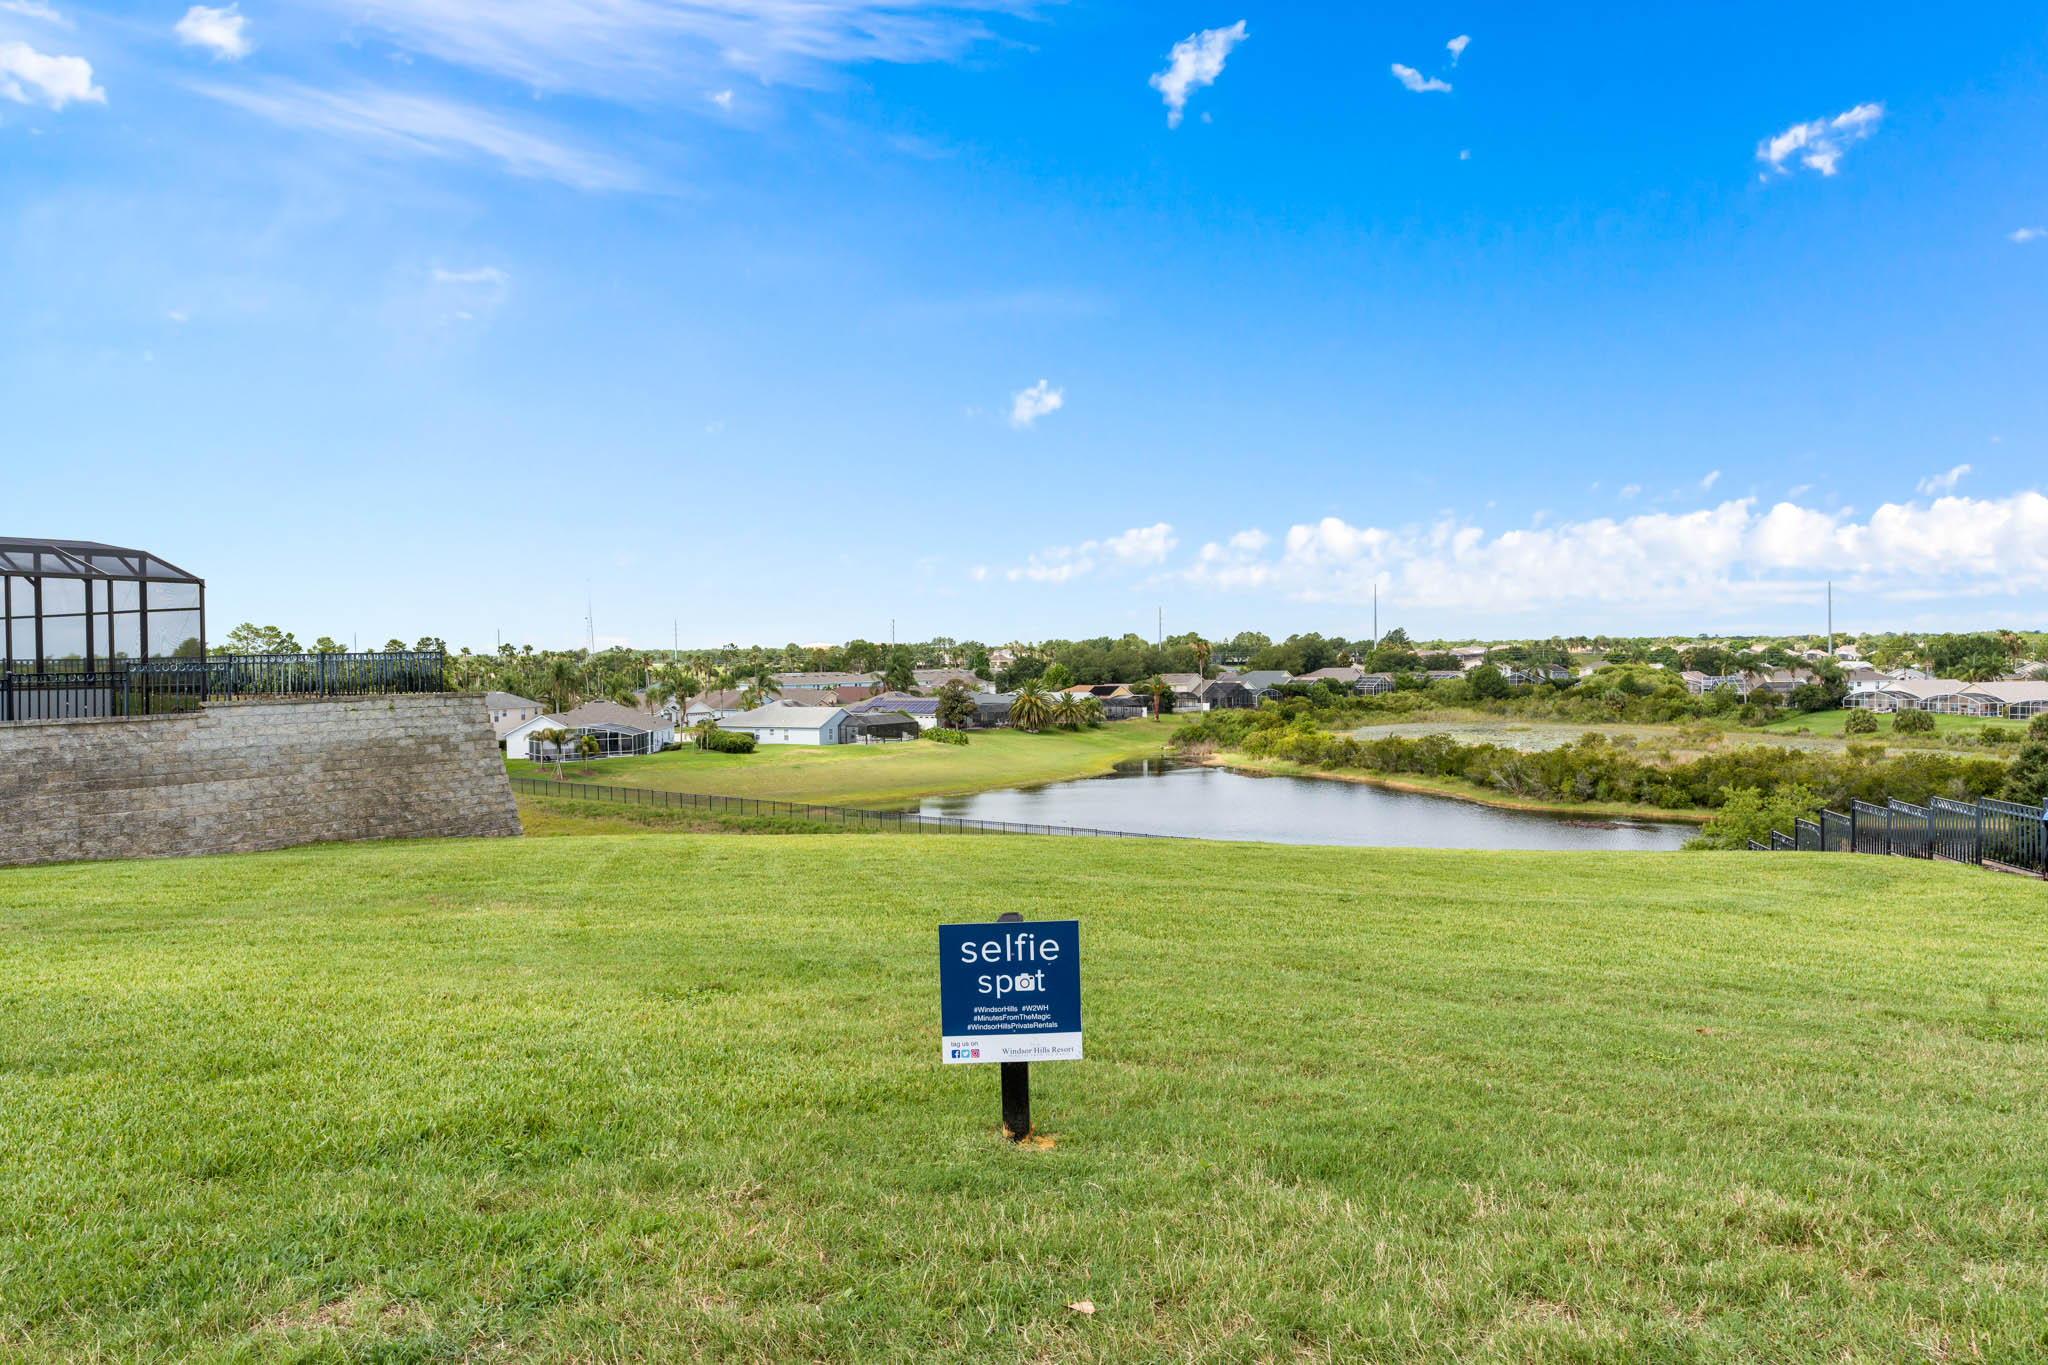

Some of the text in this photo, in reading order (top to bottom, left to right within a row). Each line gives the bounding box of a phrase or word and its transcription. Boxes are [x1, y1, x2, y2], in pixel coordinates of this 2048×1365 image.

[961, 933, 1060, 963] selfie
[973, 1014, 1051, 1022] #MinutesFromTheMagic
[967, 1022, 1058, 1031] #WindsorHillsPrivateRentals
